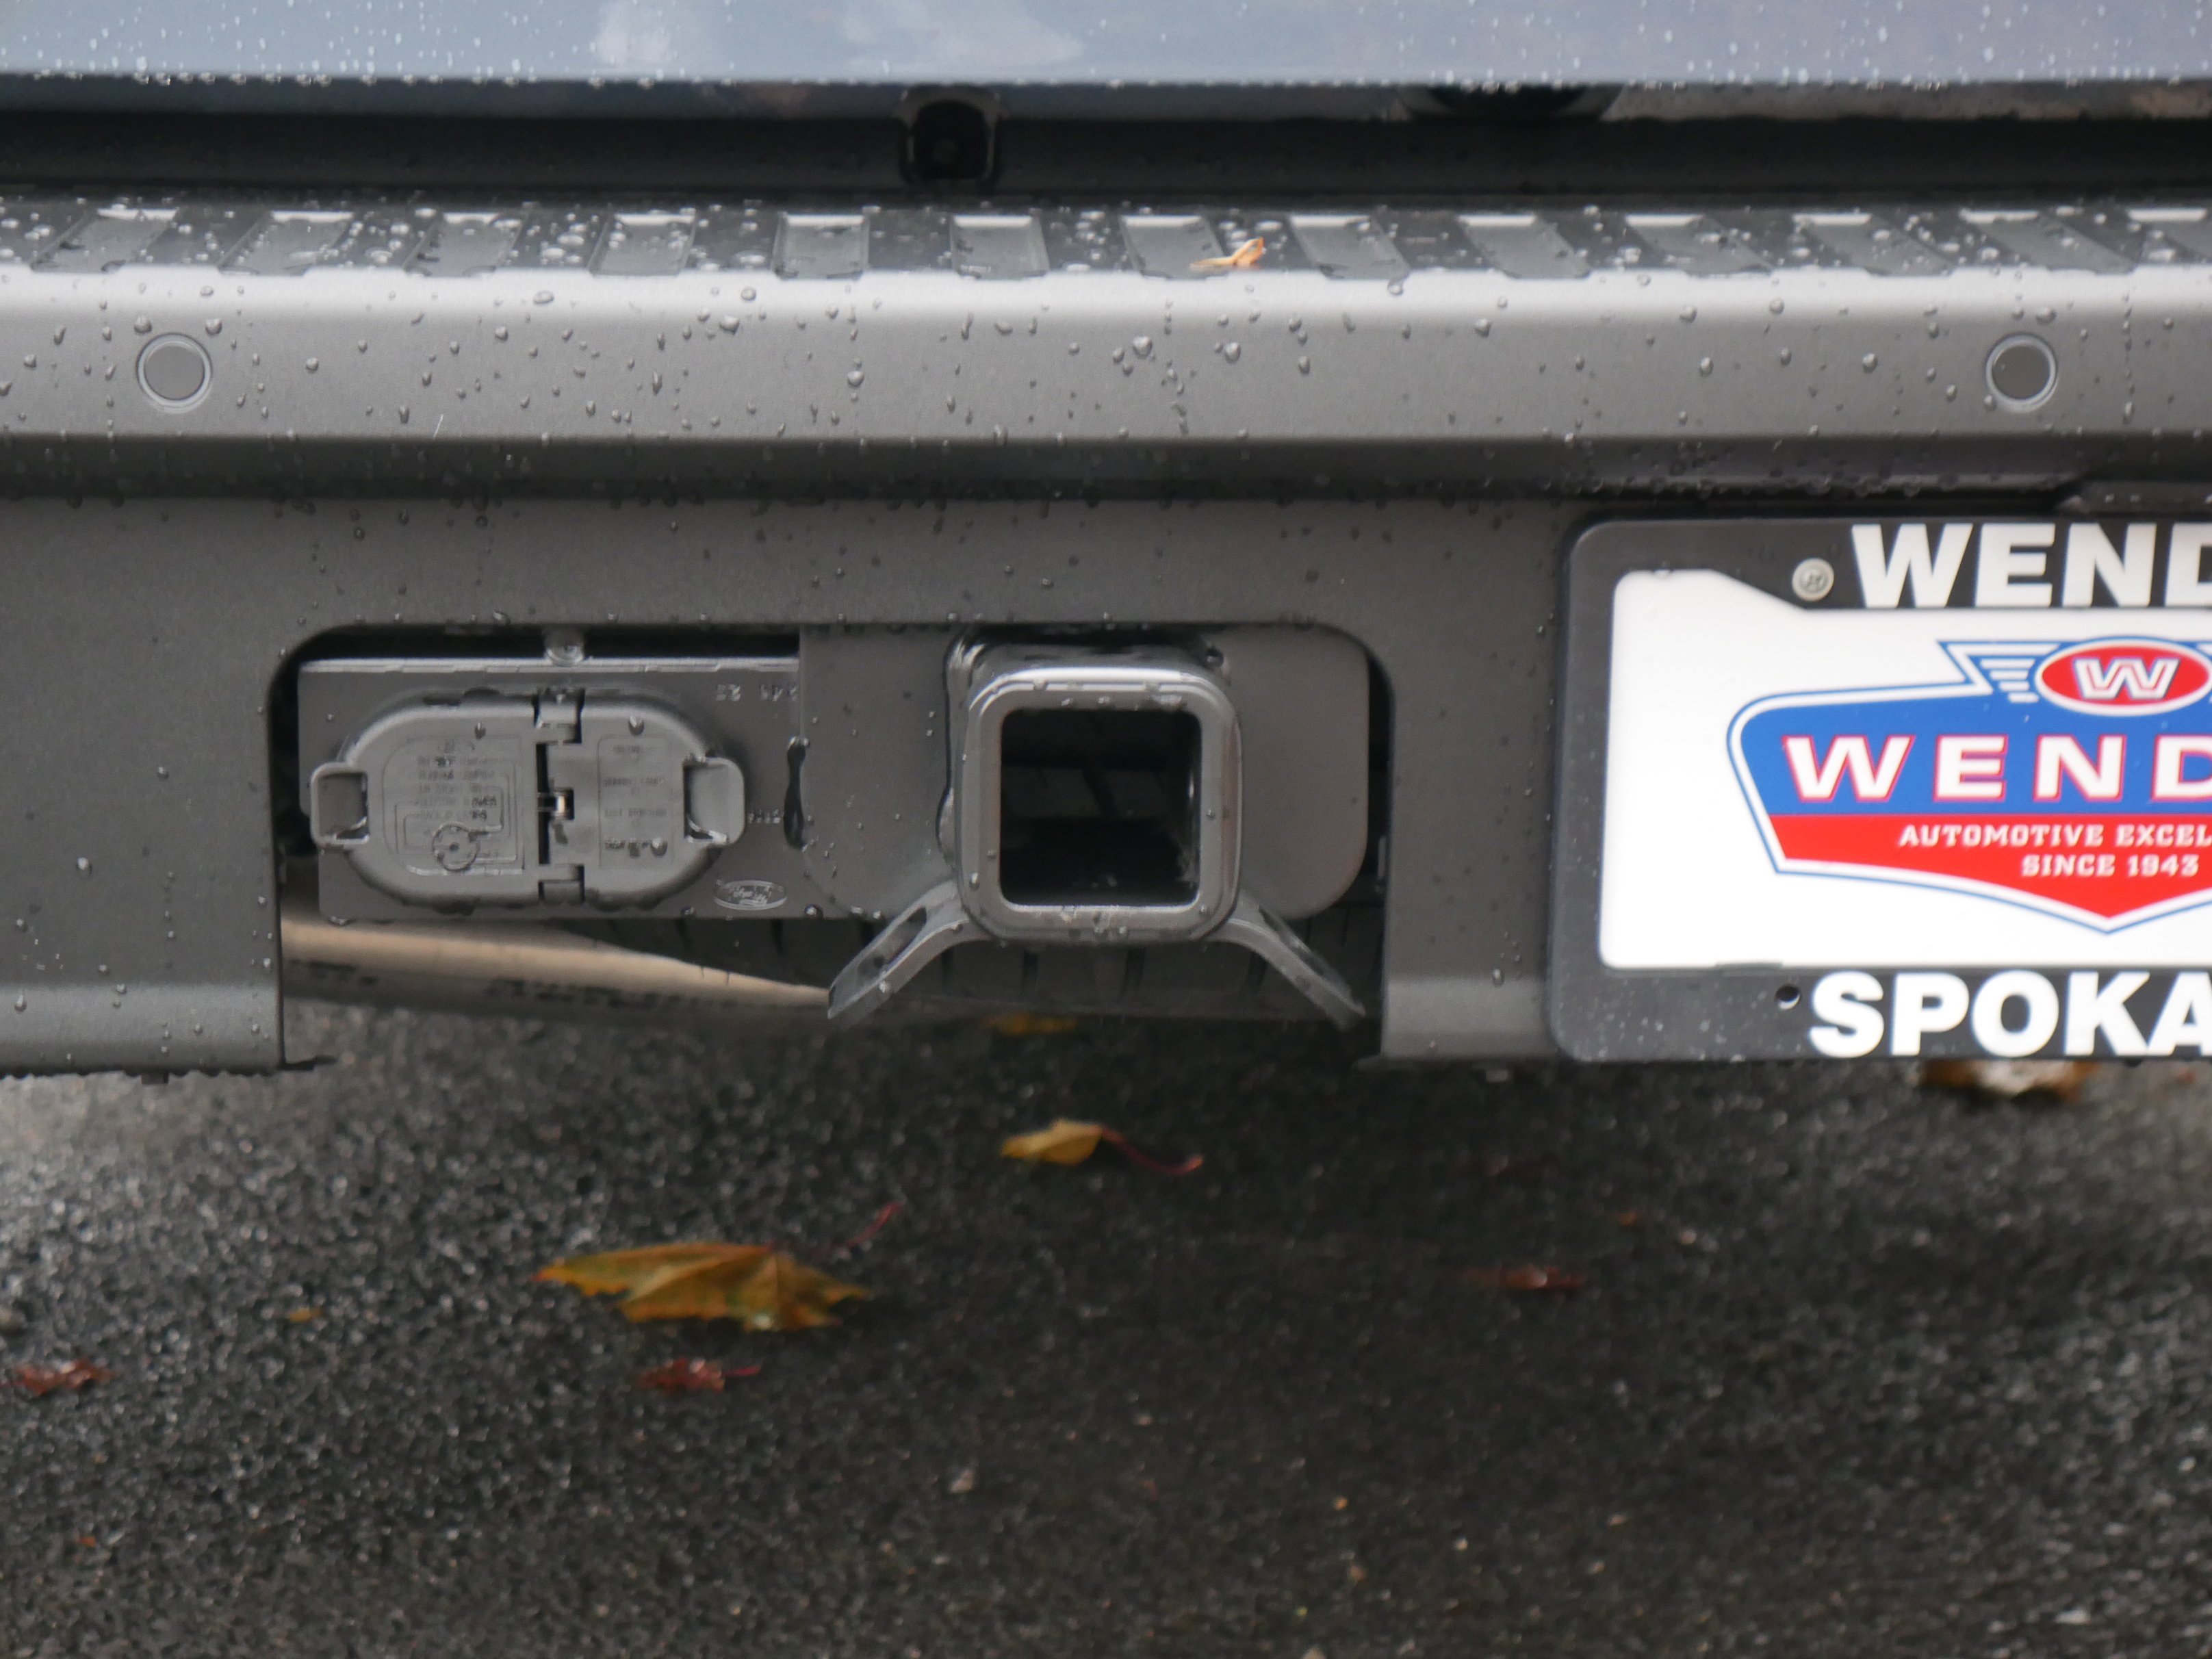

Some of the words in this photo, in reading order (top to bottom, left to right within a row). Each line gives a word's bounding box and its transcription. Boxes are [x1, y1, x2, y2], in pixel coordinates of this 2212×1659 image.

[1782, 734, 2212, 802] WEND
[1899, 823, 2105, 848] AUTOMOTIVE
[2114, 823, 2212, 848] EXCEL
[2020, 853, 2116, 877] SINCE
[2126, 853, 2200, 877] 1943
[1808, 970, 2212, 1058] SPOKA
